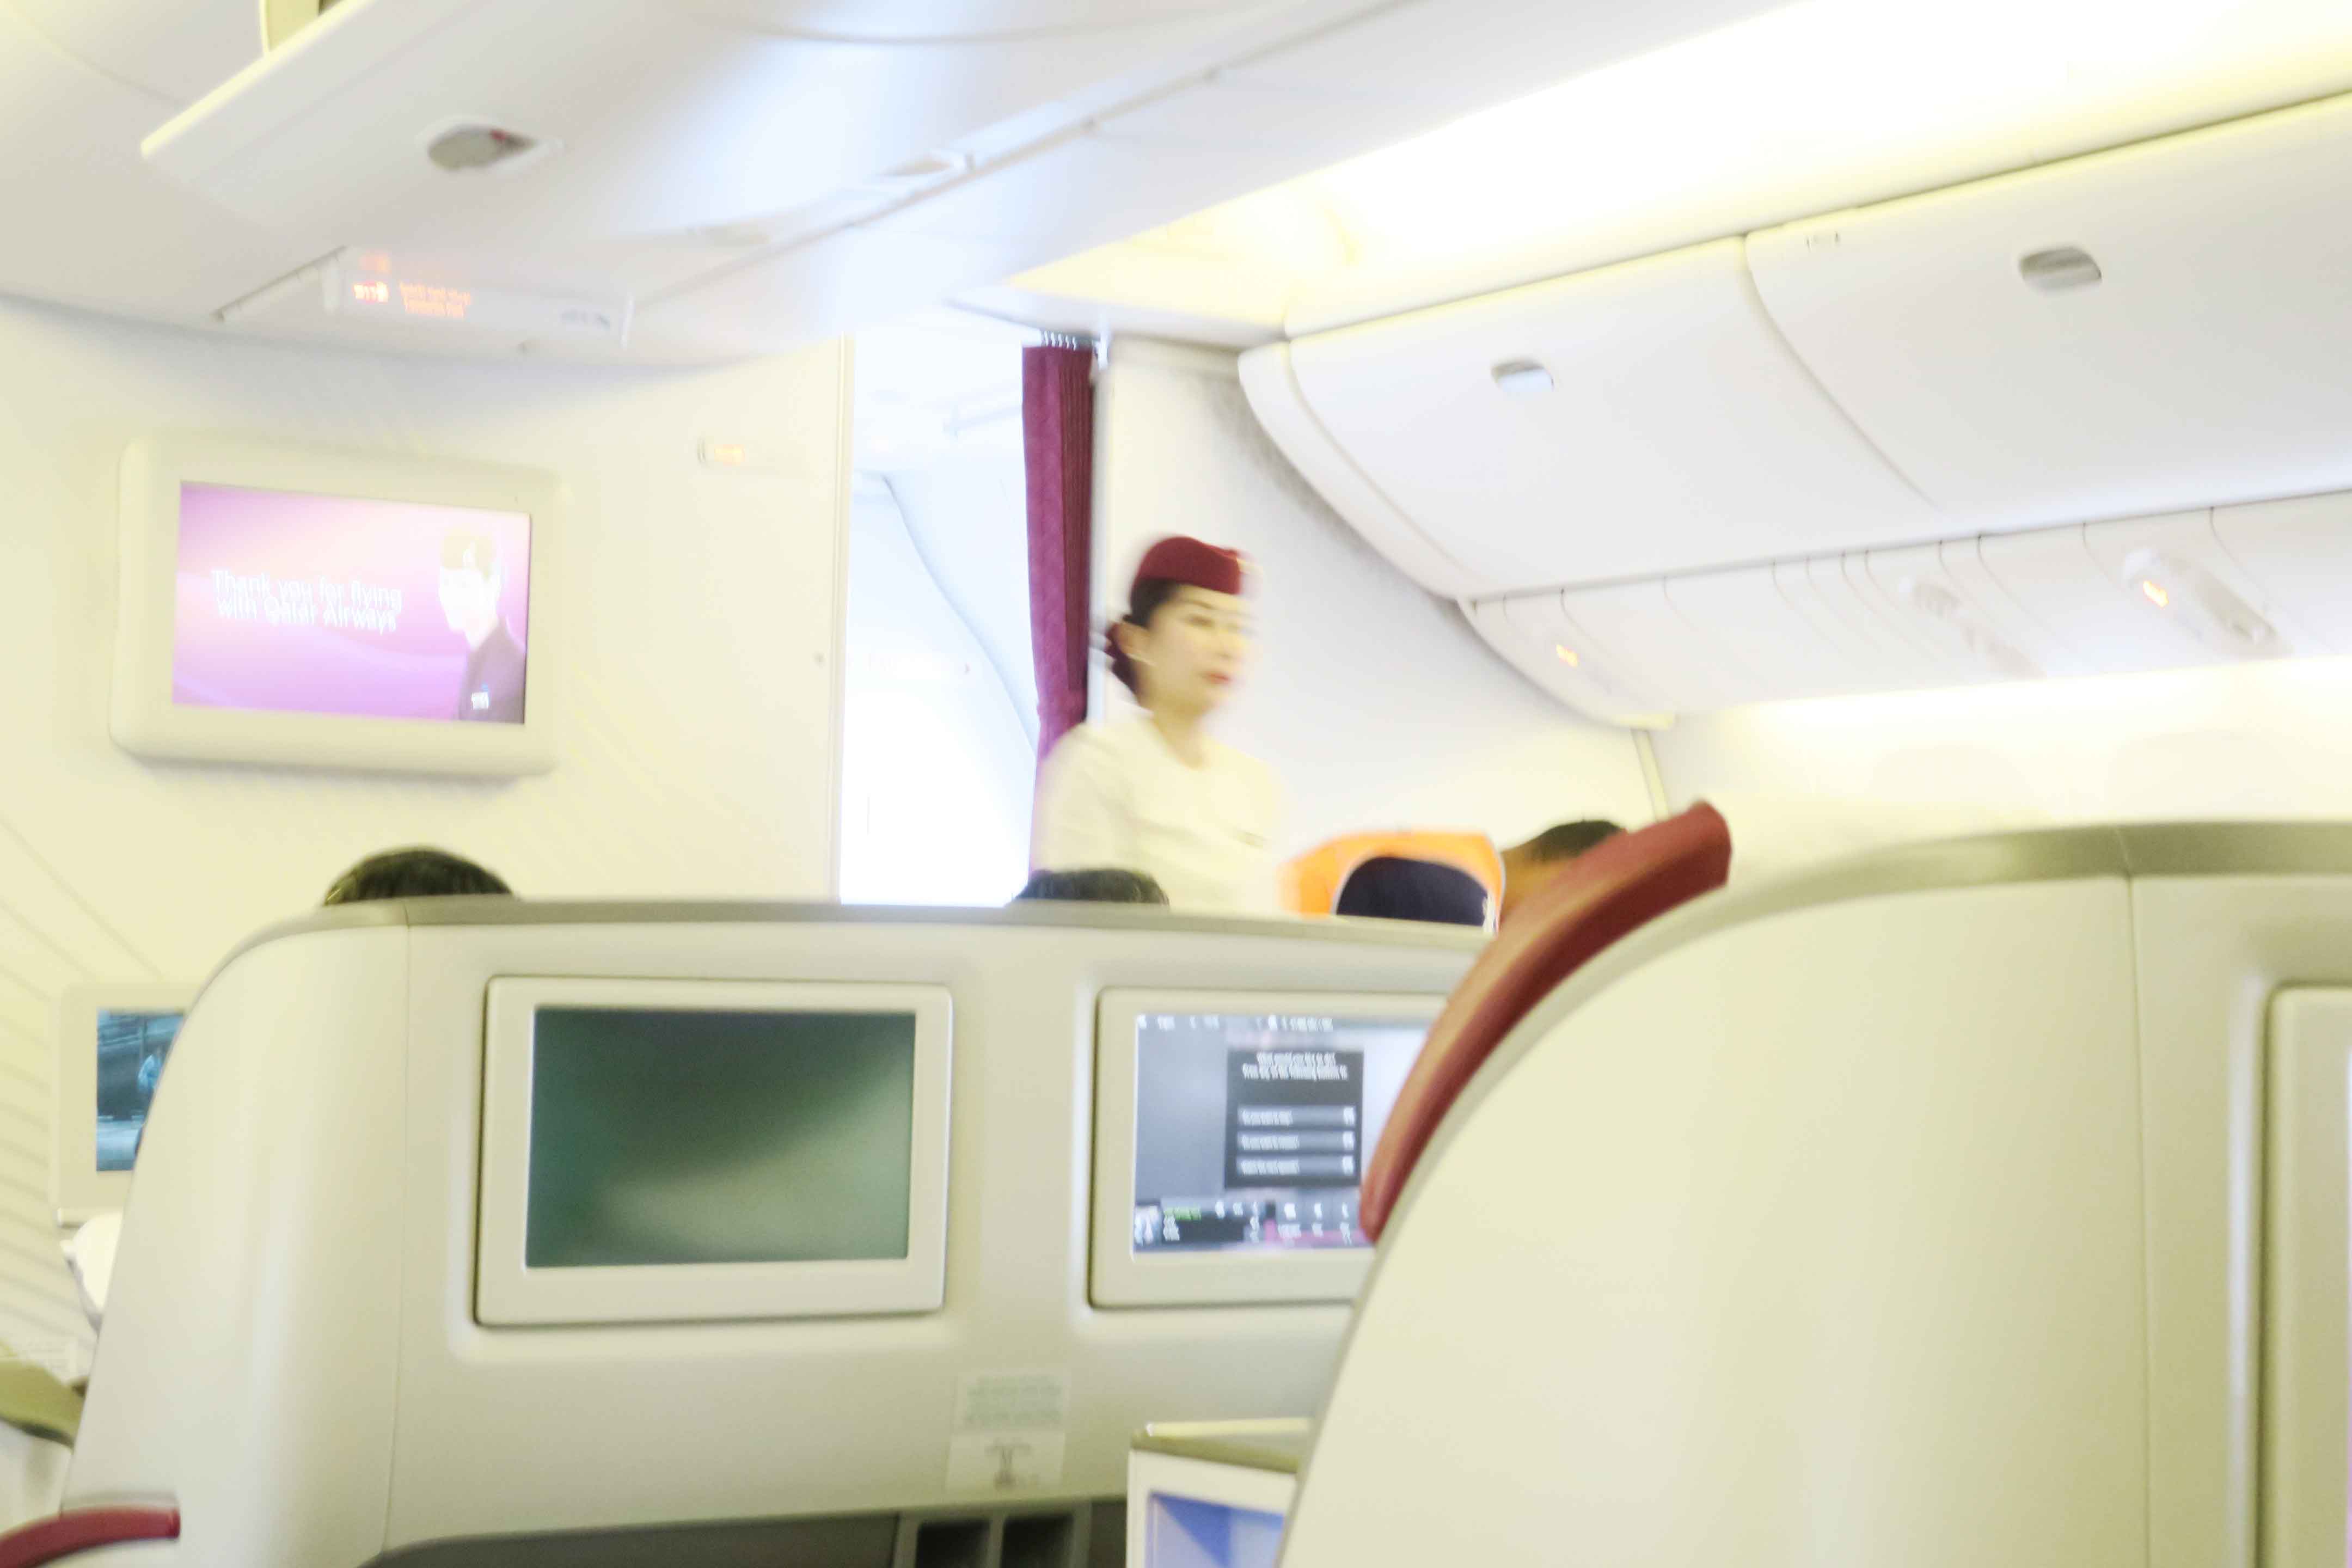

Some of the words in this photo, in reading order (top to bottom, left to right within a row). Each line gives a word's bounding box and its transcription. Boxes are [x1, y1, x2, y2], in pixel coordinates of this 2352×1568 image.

[211, 569, 270, 597] Thank
[278, 578, 313, 602] you
[319, 576, 344, 600] for
[351, 580, 402, 611] flying
[217, 595, 258, 620] with
[264, 596, 317, 626] Qatar
[323, 601, 397, 635] Airways
